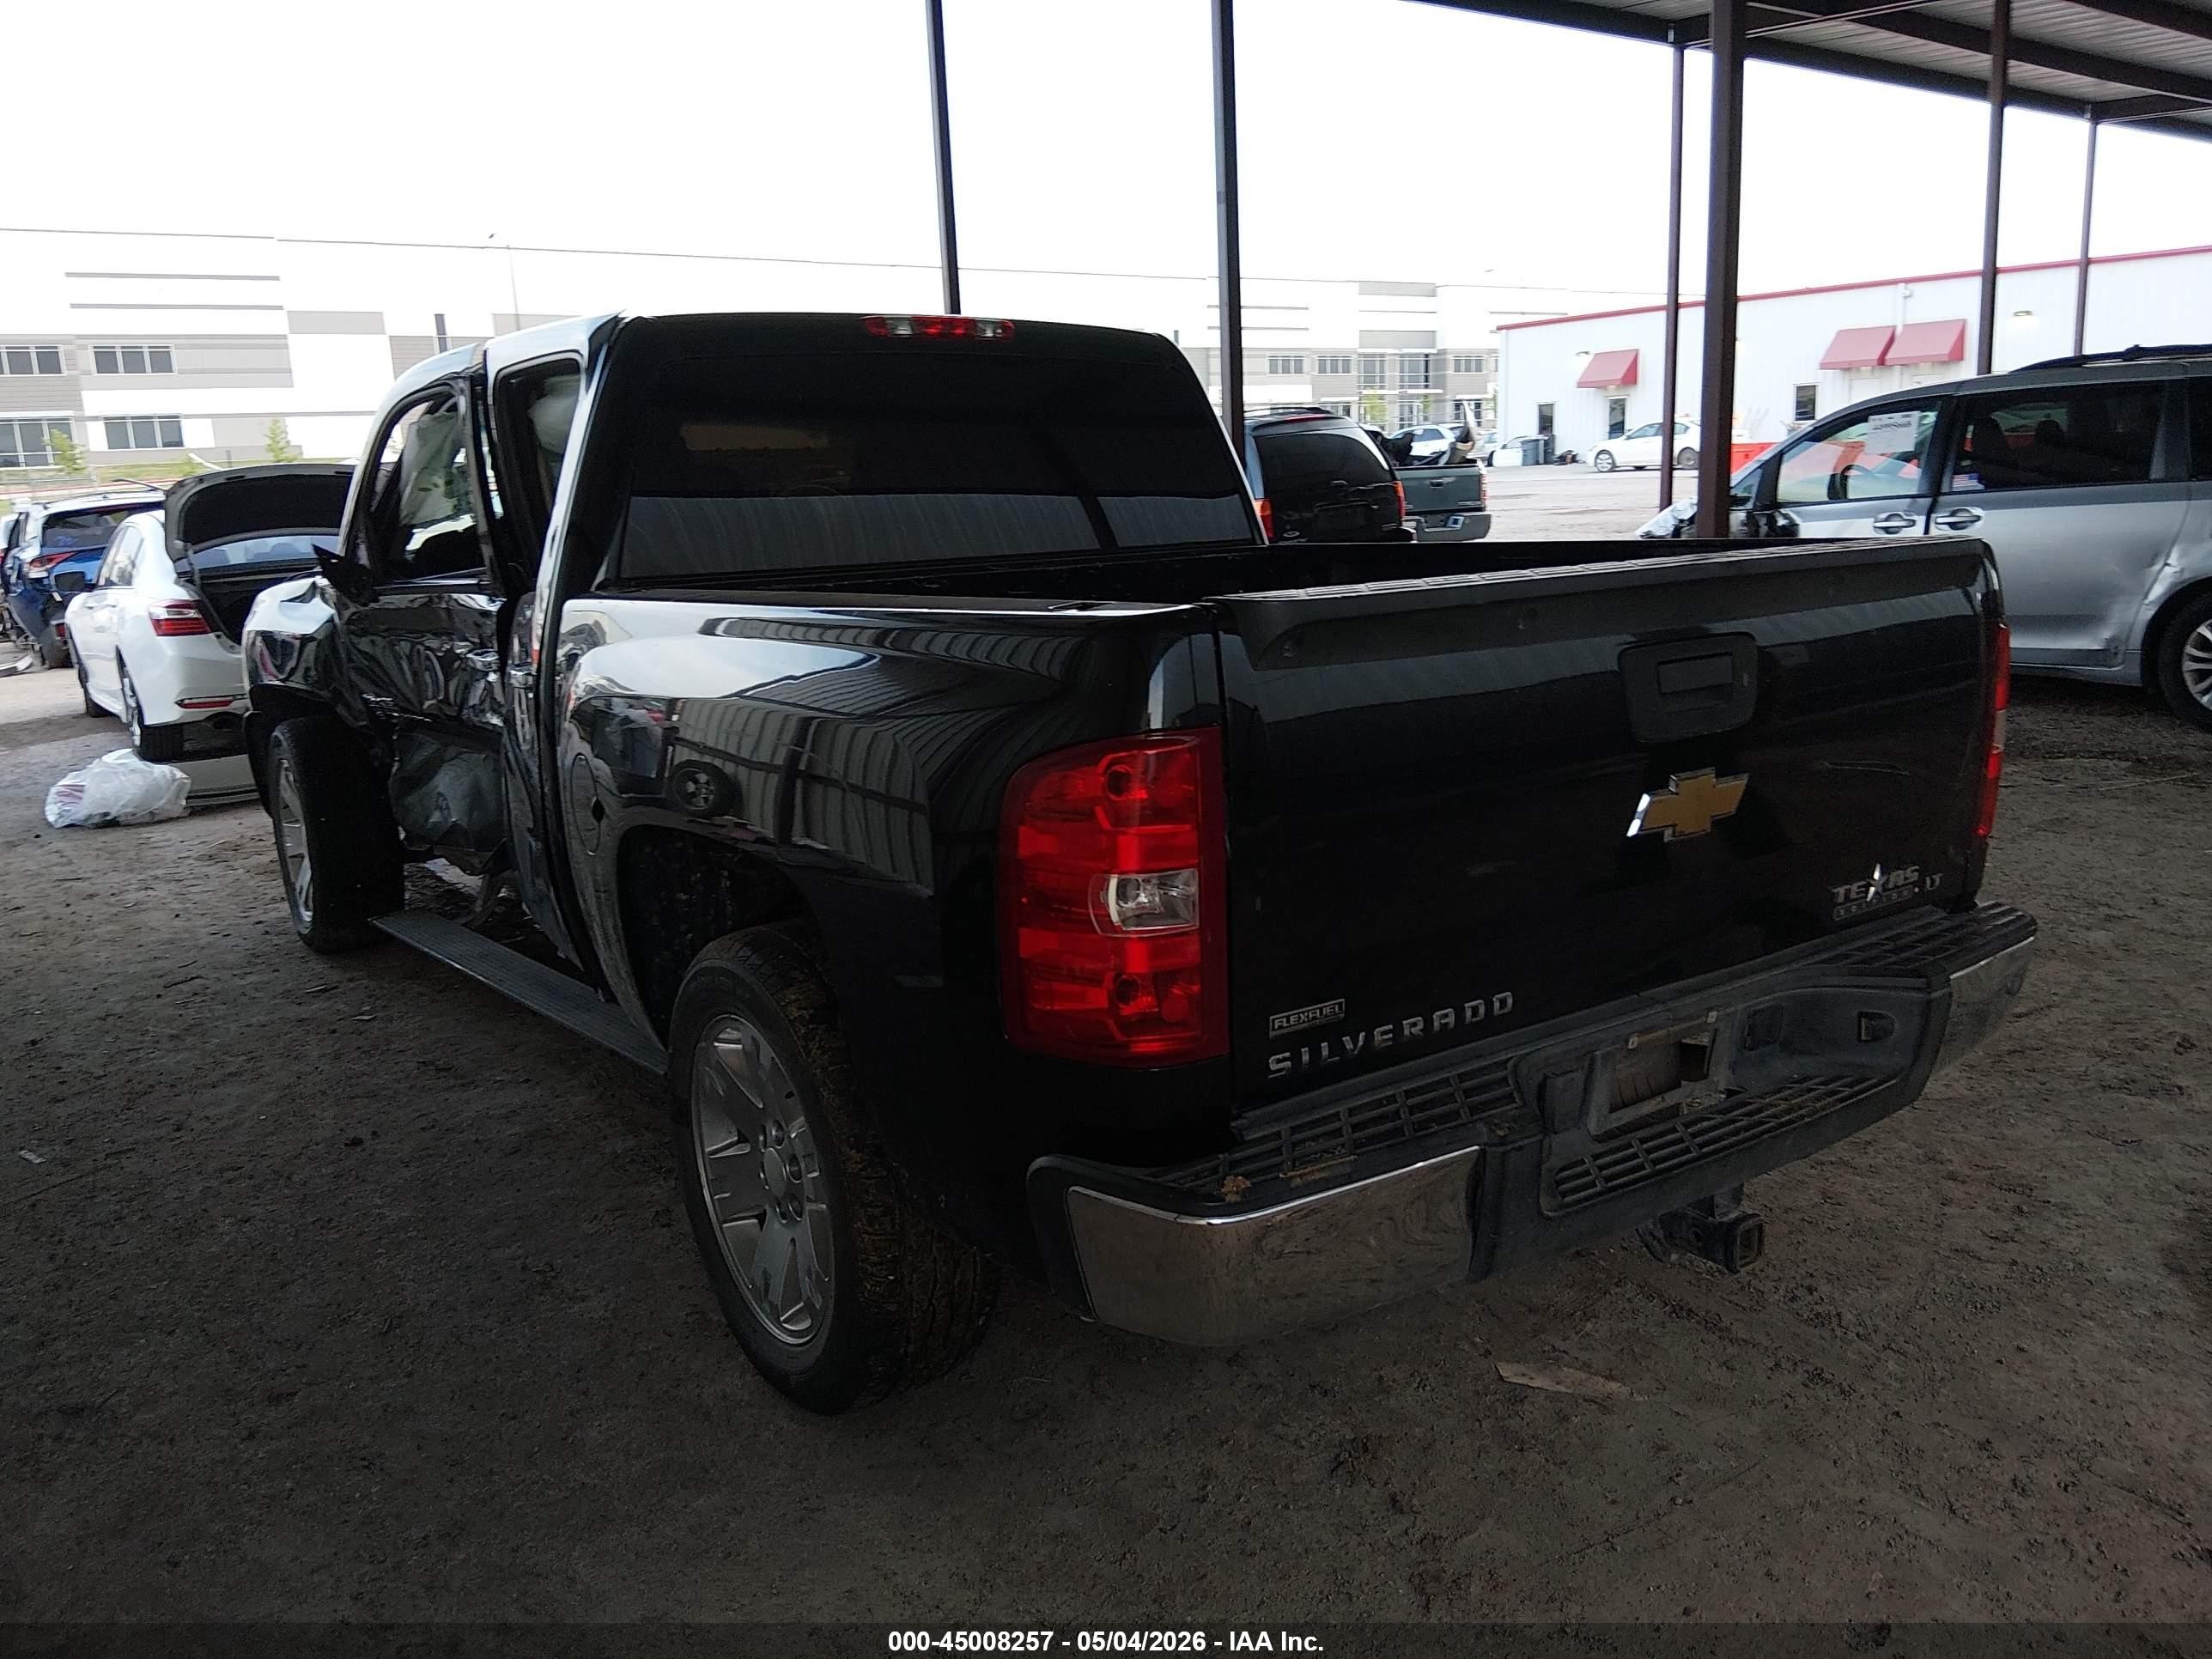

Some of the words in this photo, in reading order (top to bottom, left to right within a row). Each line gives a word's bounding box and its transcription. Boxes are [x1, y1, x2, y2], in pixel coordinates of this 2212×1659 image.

[1832, 863, 1919, 903] TEXAS
[1267, 991, 1515, 1079] SILVERADO
[1273, 1002, 1344, 1030] FLEXFUEL
